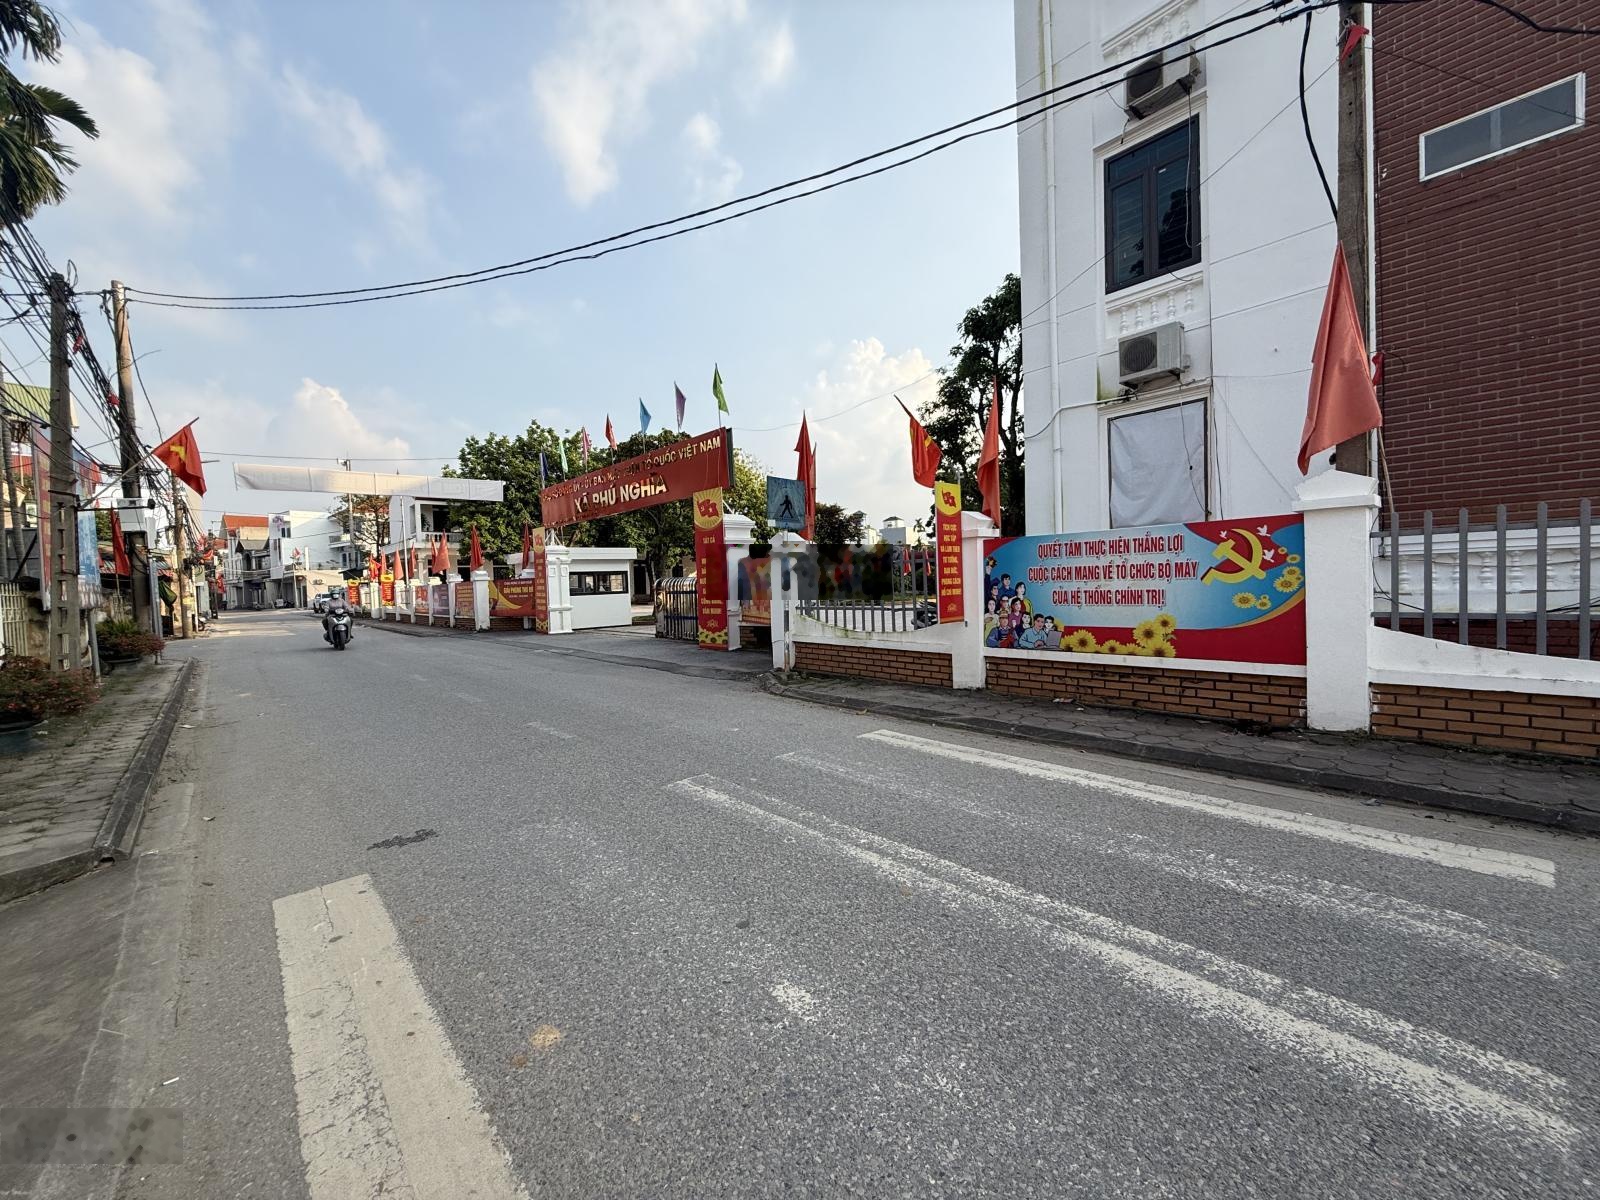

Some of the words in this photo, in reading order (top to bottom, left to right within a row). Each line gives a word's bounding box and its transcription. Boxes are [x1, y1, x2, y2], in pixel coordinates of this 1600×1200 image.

[653, 448, 677, 466] QUỐC
[678, 443, 698, 460] VIỆT
[699, 436, 721, 453] NAM
[574, 492, 590, 513] XÃ
[592, 484, 617, 507] PHÚ
[619, 472, 668, 503] NGHĨA
[1038, 539, 1062, 559] QUYẾT
[1084, 539, 1106, 559] THỰC
[1109, 536, 1130, 558] HIỆN
[1132, 531, 1165, 554] THẮNG
[1167, 533, 1183, 555] LỢI
[1028, 564, 1049, 584] CUỘC
[1051, 564, 1072, 581] CÁCH
[1074, 565, 1100, 584] MẠNG
[1115, 558, 1127, 580] TỔ
[1129, 559, 1155, 579] CHỨC
[1158, 559, 1171, 582] BỘ
[1052, 586, 1069, 605] CỦA
[1070, 587, 1081, 608] HỆ
[1083, 585, 1112, 605] THỐNG
[1115, 586, 1143, 605] CHÍNH
[1145, 589, 1165, 608] TRỊ!
